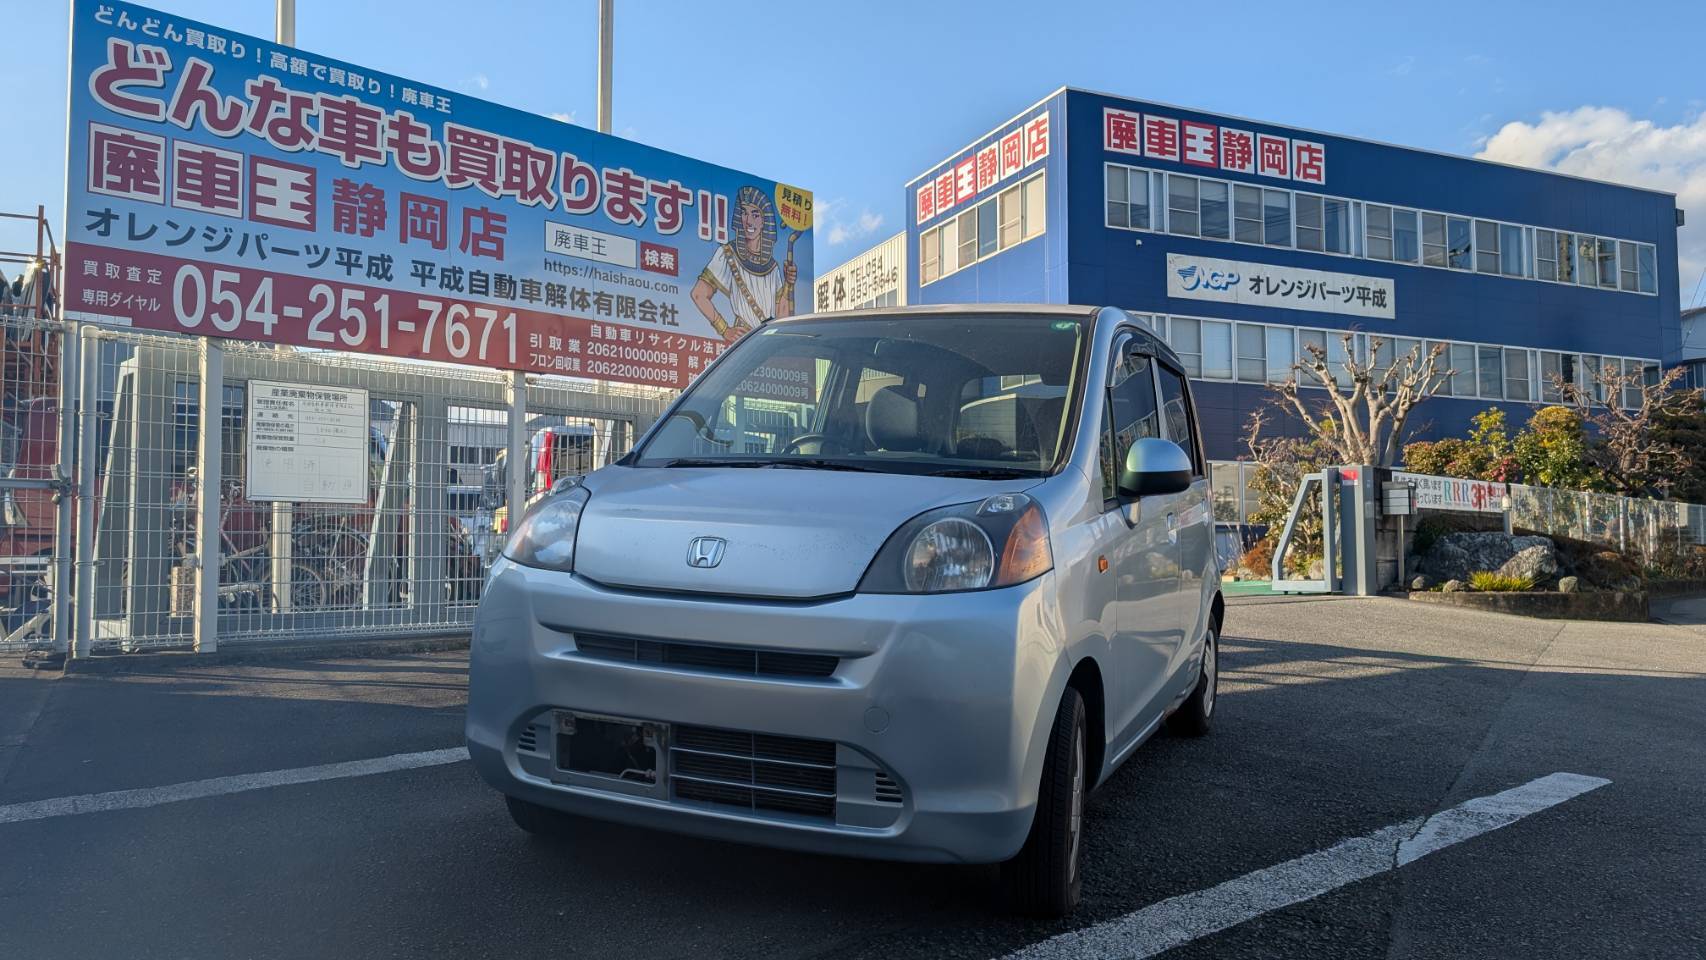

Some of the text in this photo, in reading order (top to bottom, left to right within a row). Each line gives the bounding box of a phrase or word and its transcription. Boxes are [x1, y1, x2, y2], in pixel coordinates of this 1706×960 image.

[1105, 110, 1323, 183] 廃車王静岡店
[918, 116, 1048, 222] 廃車王静岡店
[85, 207, 680, 327] オレンジパーツ平成 平成自動車解体有限会社
[554, 229, 676, 271] 廃車王 検索
[83, 259, 162, 286] 買取査定
[543, 258, 679, 295] https://haishaou.com
[82, 288, 161, 313] 専用ダイヤル
[1249, 276, 1387, 309] オレンジパーツ平成
[173, 264, 516, 364] 054-251-7671
[530, 333, 580, 354] 引取業
[587, 341, 679, 367] 20621000009号
[591, 324, 731, 355] 自動車リサイクル法許
[530, 353, 581, 373] フロン回収業
[587, 360, 679, 385] 20622000009号
